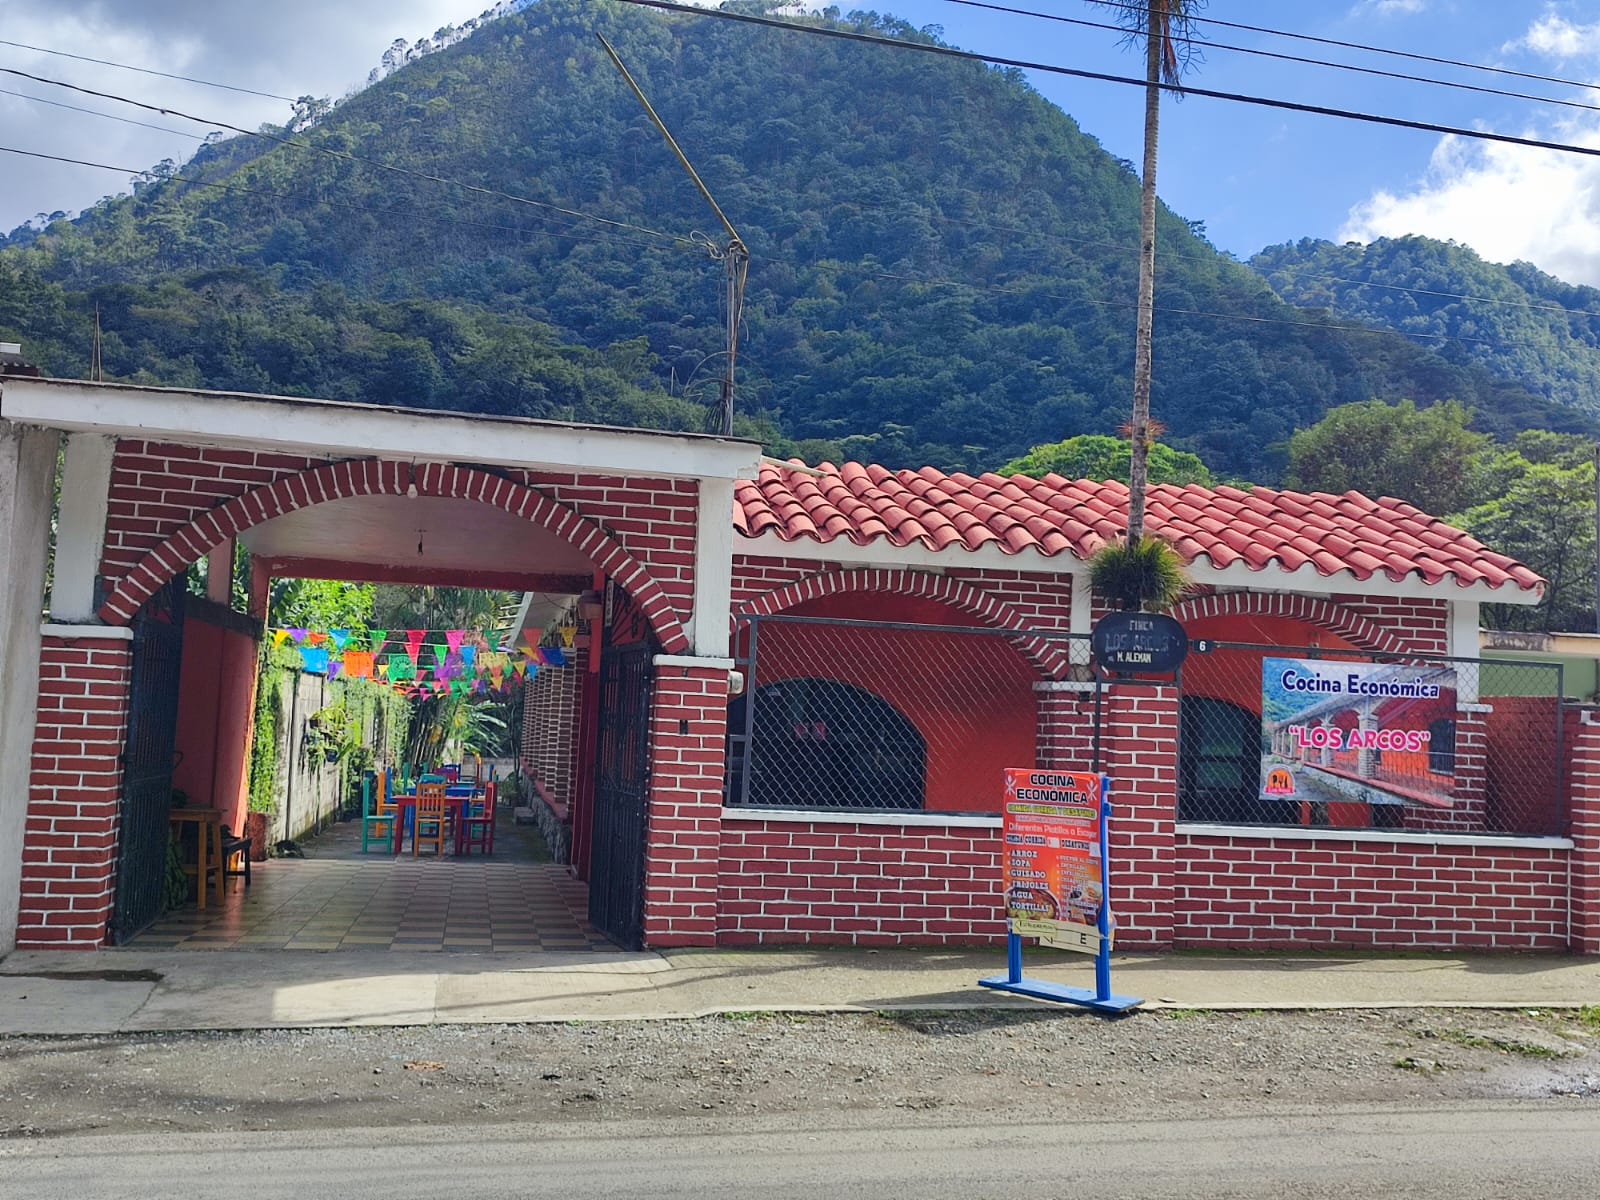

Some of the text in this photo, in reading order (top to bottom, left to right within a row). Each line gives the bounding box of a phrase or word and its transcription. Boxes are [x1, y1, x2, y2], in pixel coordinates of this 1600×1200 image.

[1198, 641, 1207, 652] 6
[1282, 670, 1439, 698] Cocina Económica
[1030, 773, 1075, 787] COCINA
[1016, 788, 1088, 804] ECONÓMICA
[1011, 849, 1038, 858] ARROZ
[1011, 859, 1031, 867] SOPA
[1010, 869, 1046, 878] GUISADO
[1012, 880, 1049, 890] FRIJOLES
[1012, 891, 1033, 900] AGUA
[1011, 901, 1049, 912] TORTILLAS
